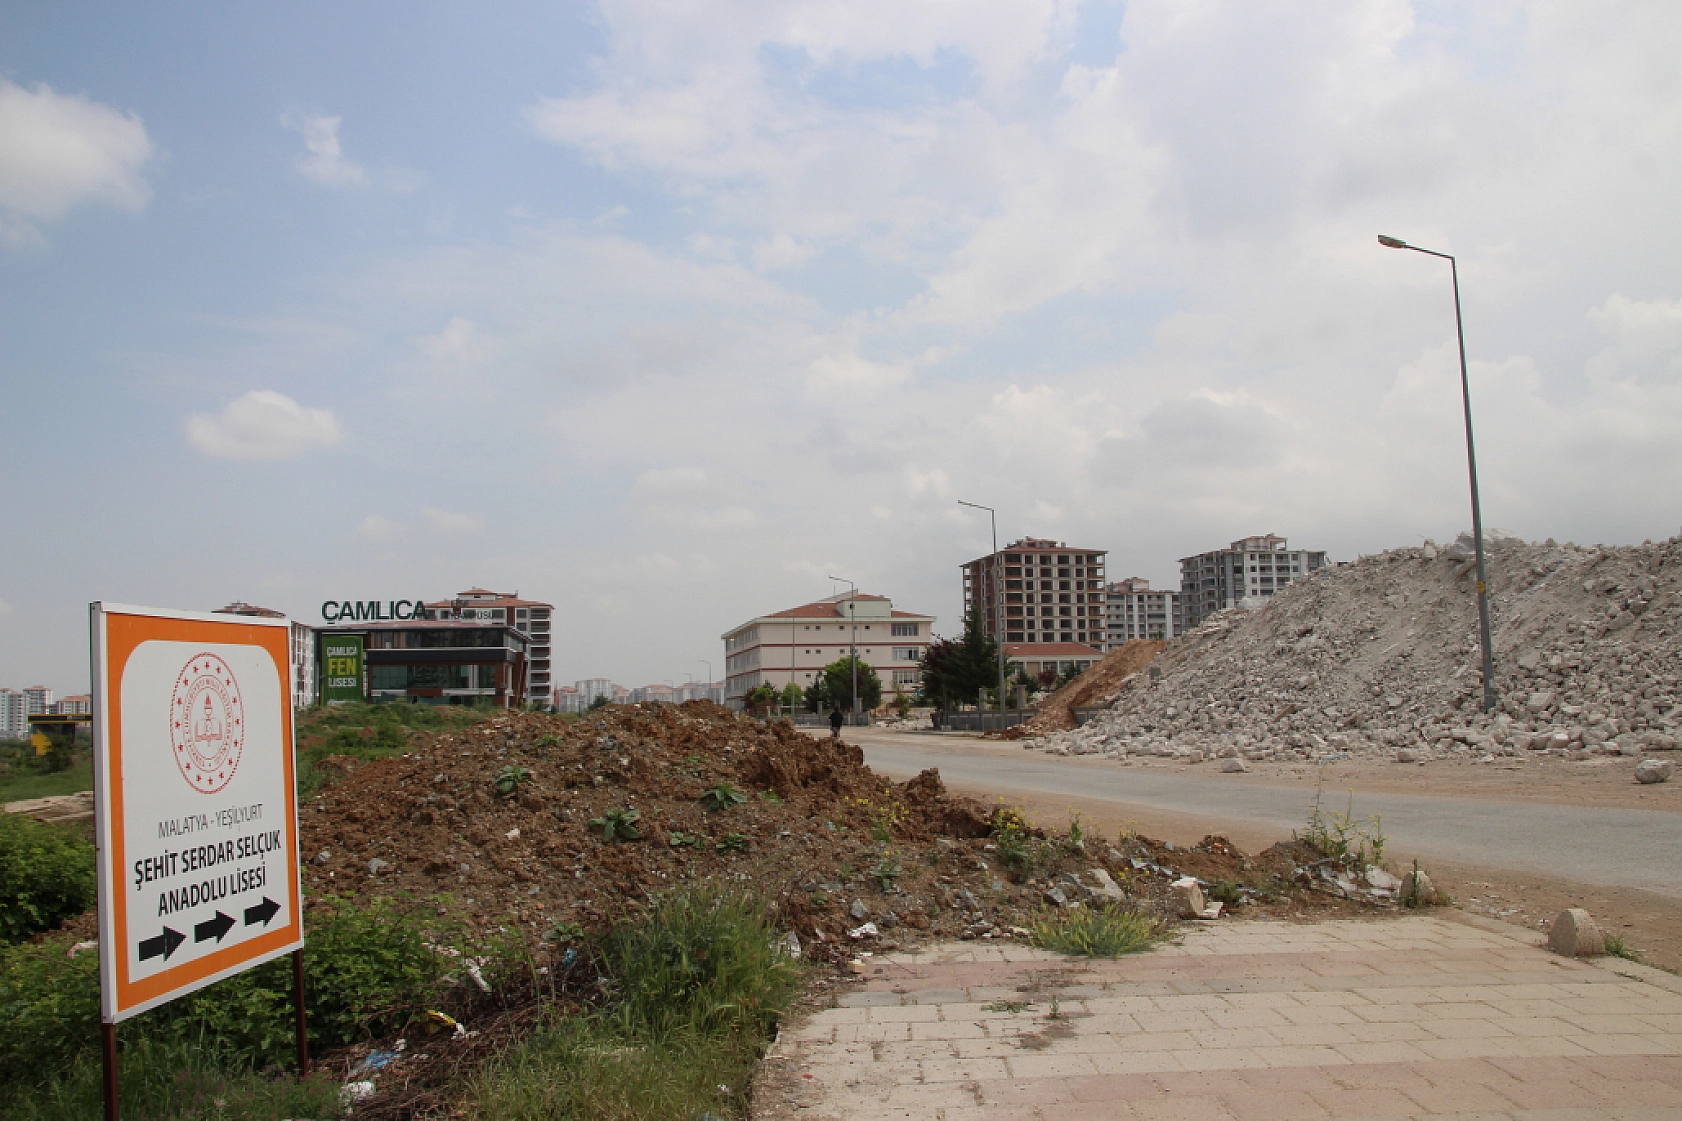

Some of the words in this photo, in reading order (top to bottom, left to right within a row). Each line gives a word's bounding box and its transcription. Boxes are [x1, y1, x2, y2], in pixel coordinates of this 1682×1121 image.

[321, 600, 428, 624] ÇAMLICA
[328, 658, 357, 675] FEN
[158, 814, 208, 838] MALATYA
[215, 803, 263, 829] YEŞİLYURT
[134, 849, 178, 891] ŞEHİT
[181, 840, 234, 873] SERDAR
[237, 830, 281, 860] SELÇUK
[158, 876, 227, 917] ANADOLU
[230, 861, 266, 895] LİSESİ
